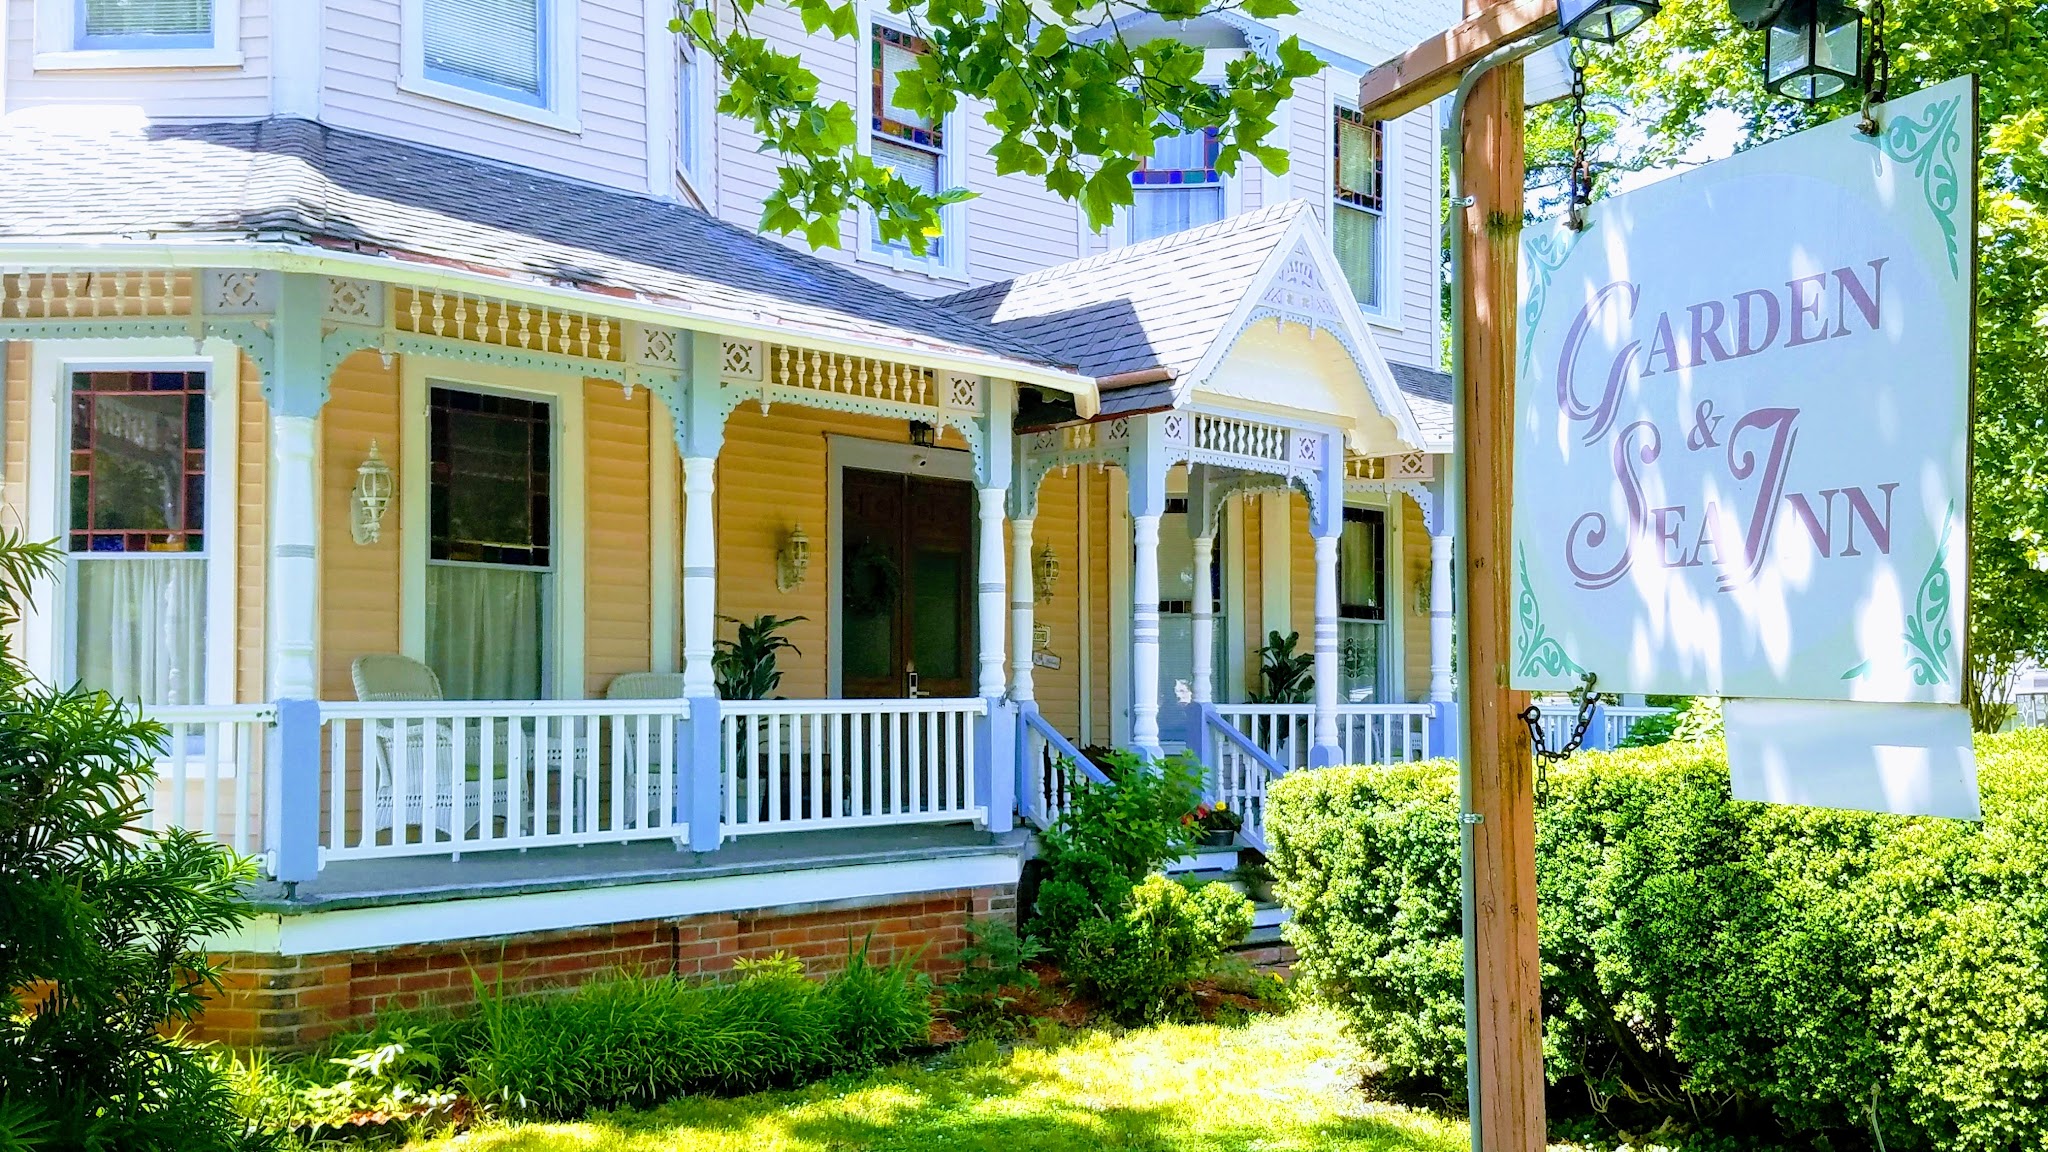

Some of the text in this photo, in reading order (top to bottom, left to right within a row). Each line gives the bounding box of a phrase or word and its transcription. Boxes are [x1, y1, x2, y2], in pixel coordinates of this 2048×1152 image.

[1556, 257, 1889, 447] GARDEN
[1687, 400, 1725, 451] &
[1566, 407, 1899, 593] SEA INN
